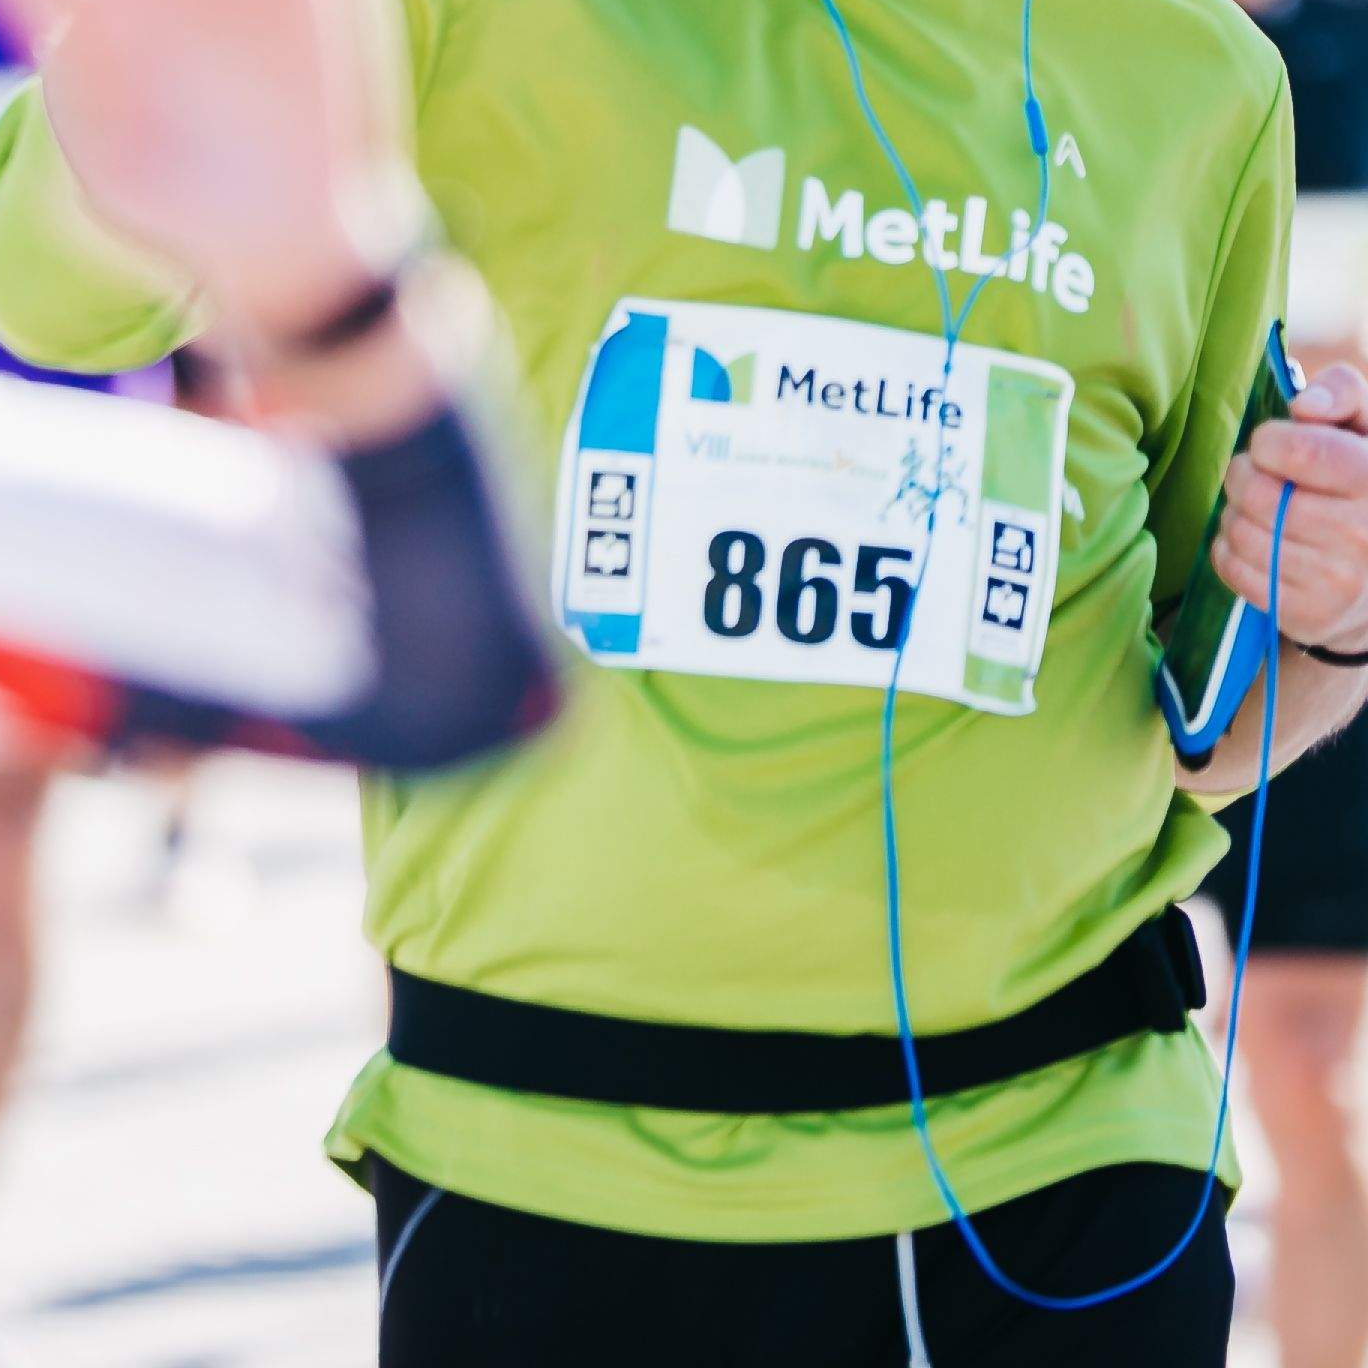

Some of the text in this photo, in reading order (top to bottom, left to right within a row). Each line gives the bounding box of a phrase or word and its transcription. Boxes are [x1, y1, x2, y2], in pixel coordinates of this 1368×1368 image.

[797, 176, 1094, 313] MetLife
[777, 364, 962, 429] MetLife
[704, 530, 913, 649] 865
